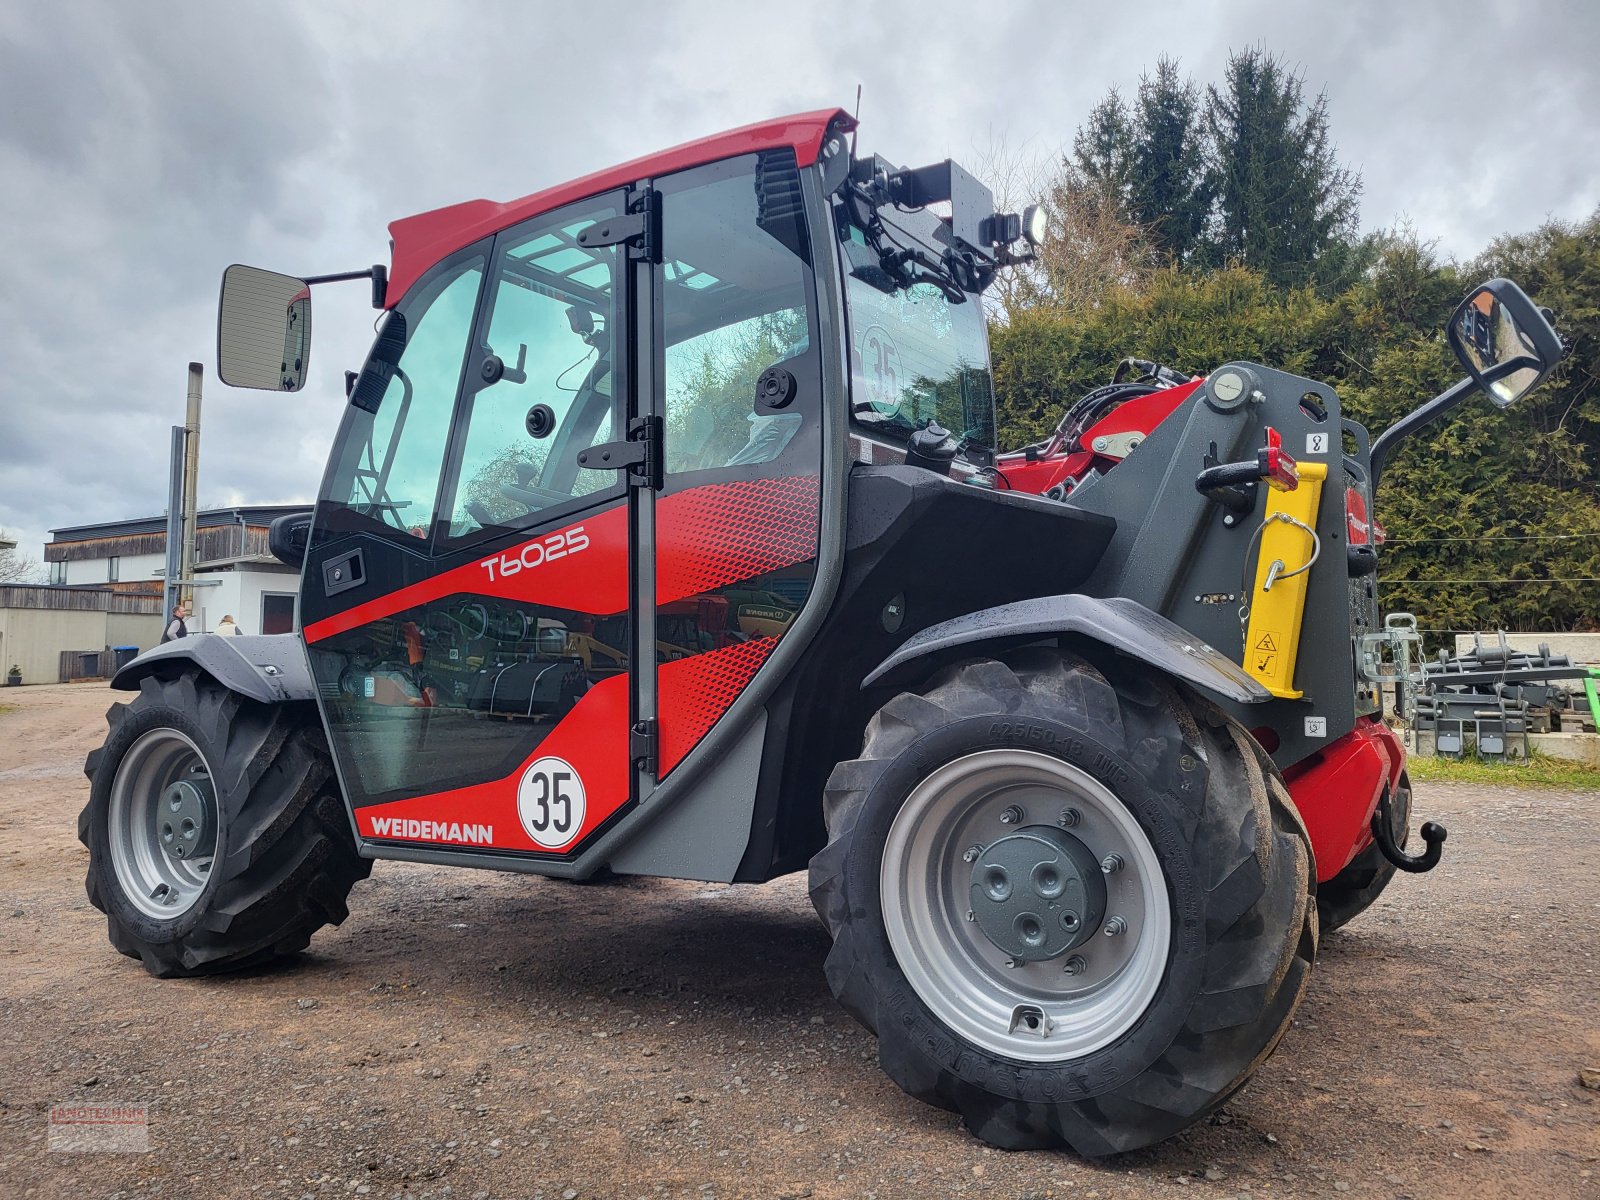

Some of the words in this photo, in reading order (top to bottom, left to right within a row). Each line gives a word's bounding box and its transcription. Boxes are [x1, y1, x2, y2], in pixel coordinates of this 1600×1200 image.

[869, 337, 897, 400] 35
[480, 526, 590, 582] T6025
[370, 816, 494, 845] WEIDEMANN
[531, 771, 572, 834] 35
